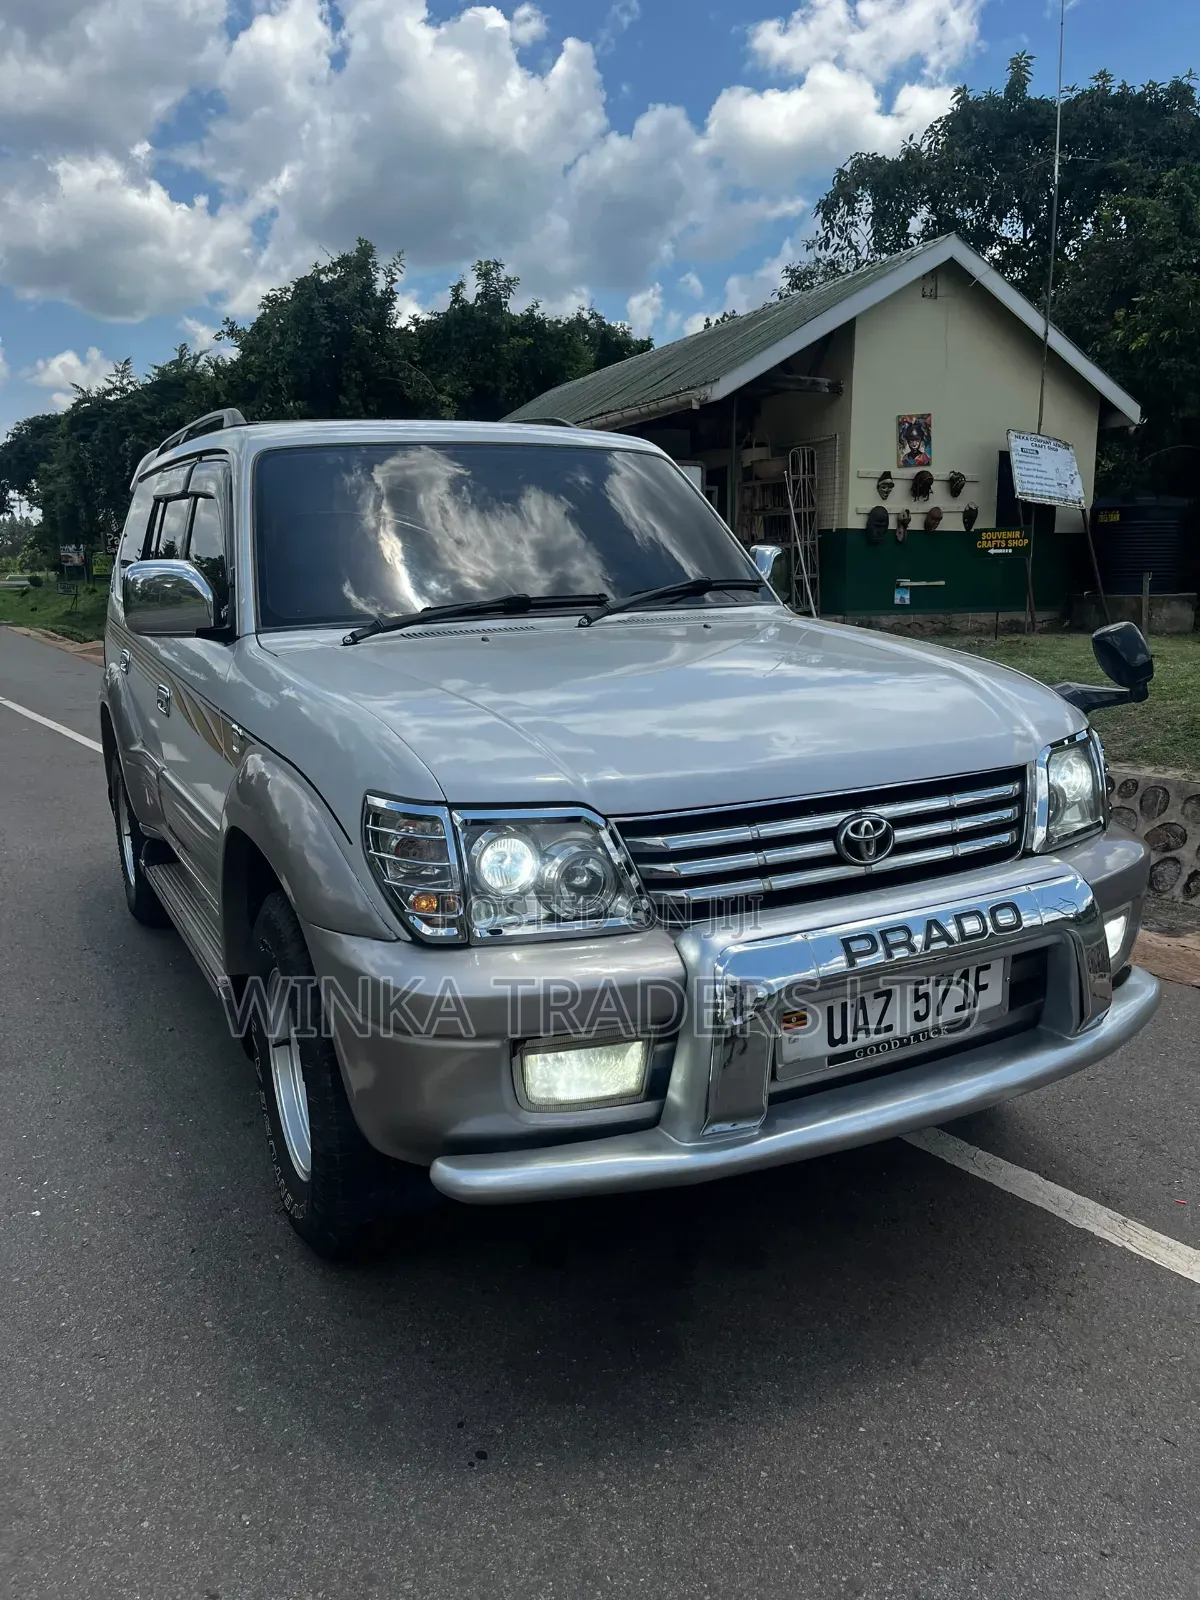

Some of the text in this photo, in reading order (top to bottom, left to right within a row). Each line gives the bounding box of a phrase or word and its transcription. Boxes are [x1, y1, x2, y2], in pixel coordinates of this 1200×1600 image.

[1029, 437, 1052, 446] COMPANY
[1030, 442, 1046, 450] CRAFT
[981, 531, 1020, 540] SOUVENIR
[976, 538, 1029, 549] CRAFTS SHOP
[838, 900, 1024, 969] PRADO
[826, 963, 992, 1048] UAZ 571F
[855, 1026, 949, 1059] GOOD LUCK
